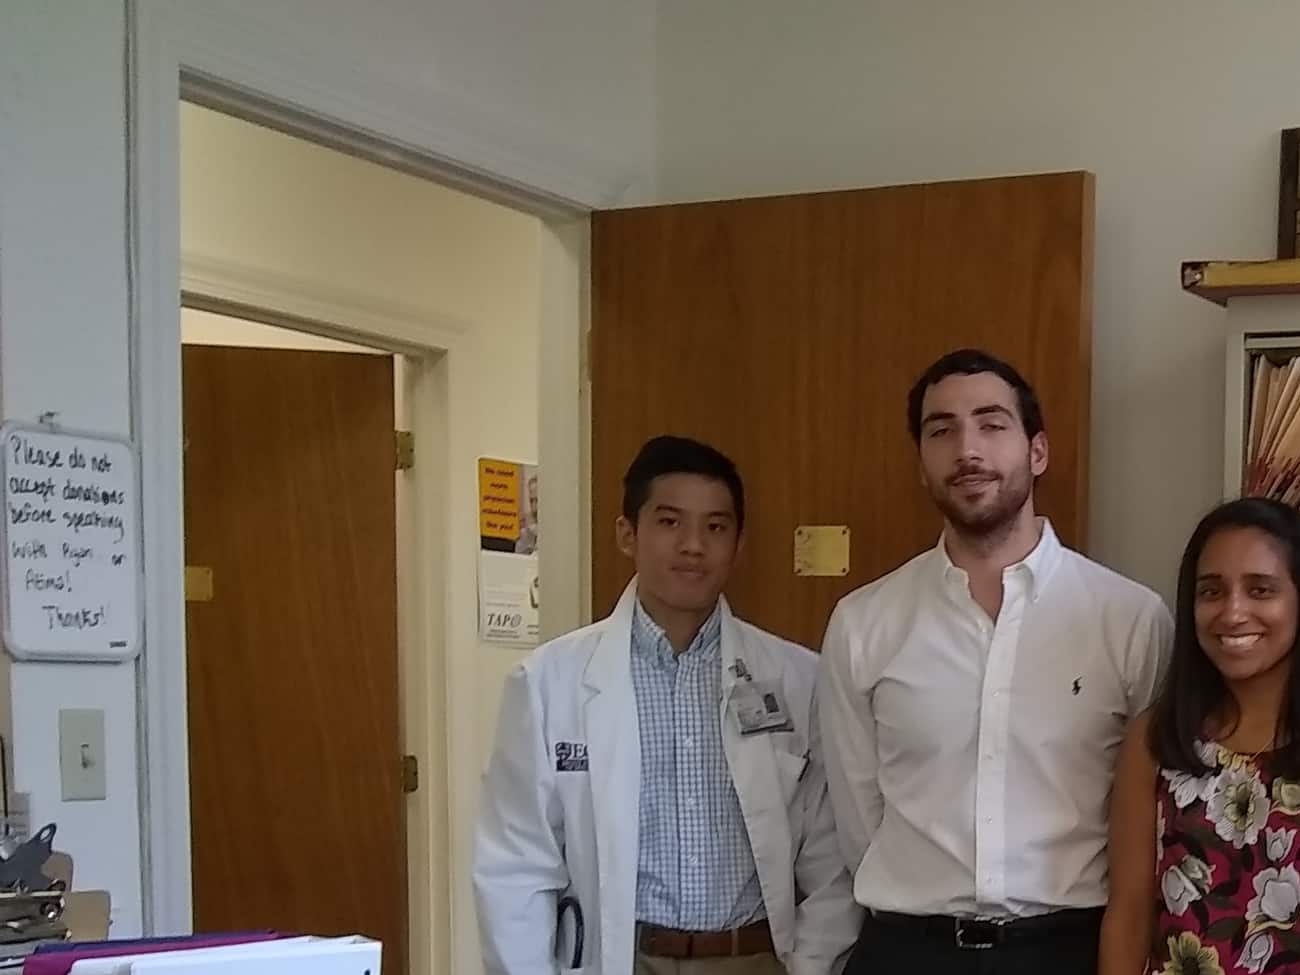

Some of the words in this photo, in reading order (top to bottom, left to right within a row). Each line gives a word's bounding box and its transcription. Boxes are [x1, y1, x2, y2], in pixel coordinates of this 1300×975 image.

[10, 434, 64, 468] Please
[69, 446, 86, 469] do
[91, 453, 112, 472] not
[10, 475, 56, 502] accept
[63, 479, 125, 505] donations
[9, 502, 56, 524] before
[62, 511, 125, 544] speaking
[12, 540, 48, 560] with
